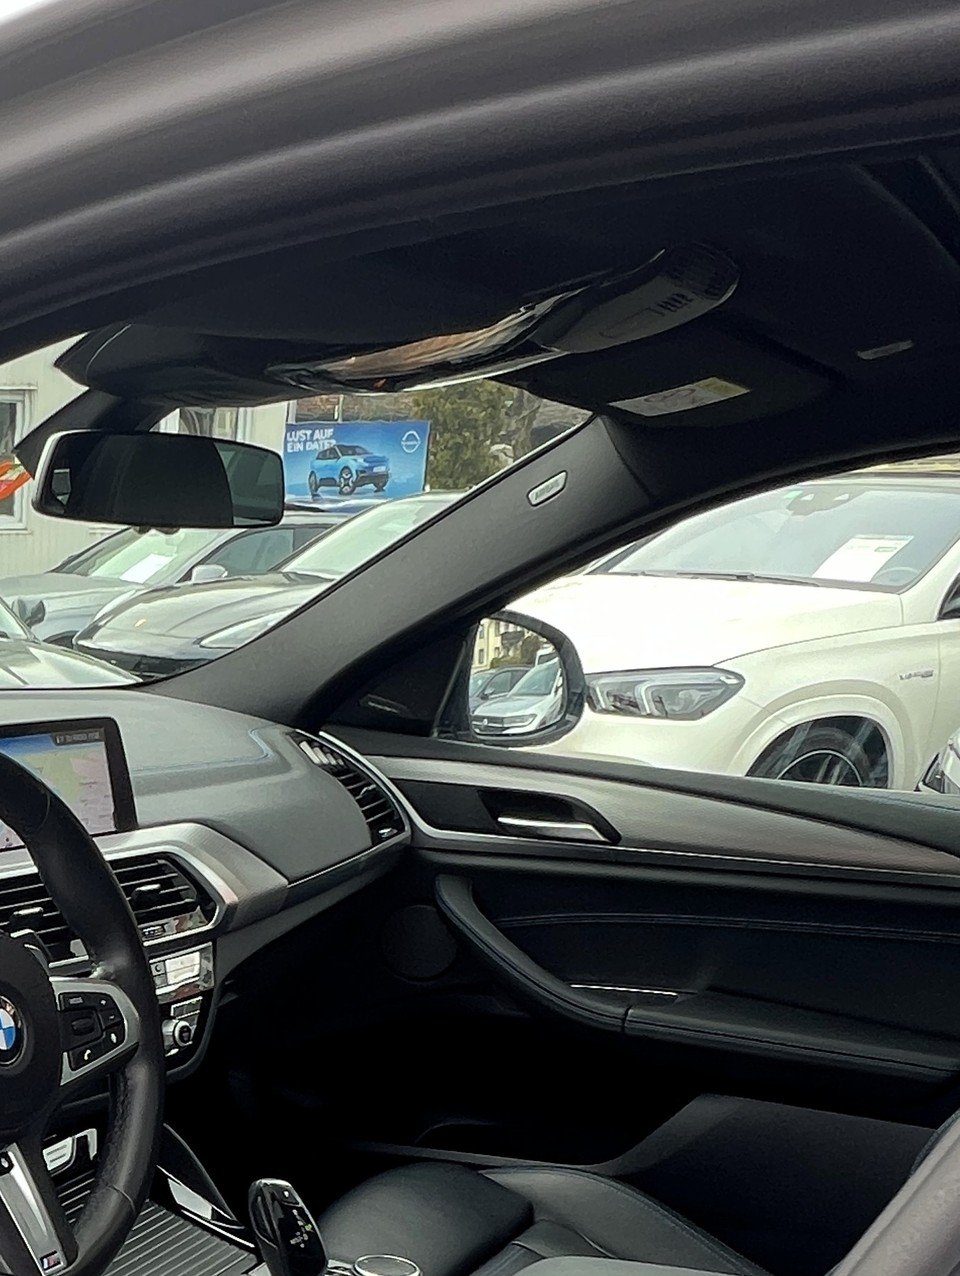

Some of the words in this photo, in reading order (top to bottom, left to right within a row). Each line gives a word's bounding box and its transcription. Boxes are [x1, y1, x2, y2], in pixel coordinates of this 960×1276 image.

[287, 430, 312, 441] LUST
[313, 428, 334, 440] AUF
[287, 441, 304, 453] EIN
